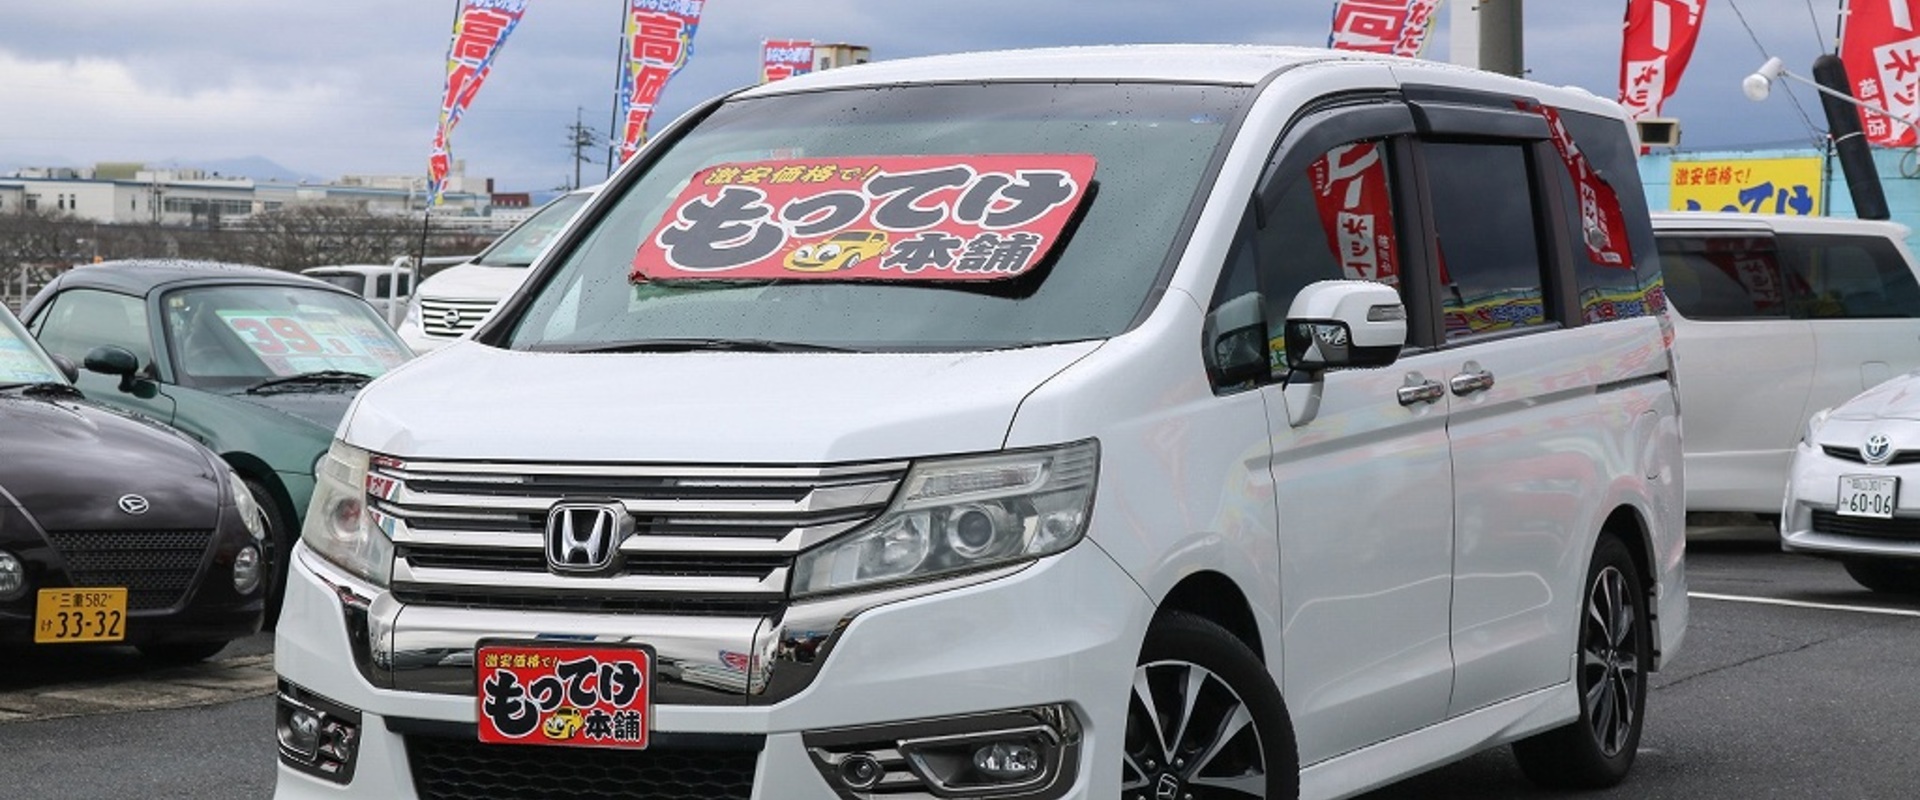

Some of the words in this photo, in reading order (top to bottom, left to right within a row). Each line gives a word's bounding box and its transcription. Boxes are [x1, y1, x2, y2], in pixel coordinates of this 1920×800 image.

[655, 163, 1077, 271] もってけ
[880, 232, 1041, 273] 本舗
[41, 619, 53, 632] け
[56, 610, 121, 638] 33-32
[483, 656, 643, 738] もってけ
[584, 708, 642, 742] 本舗
